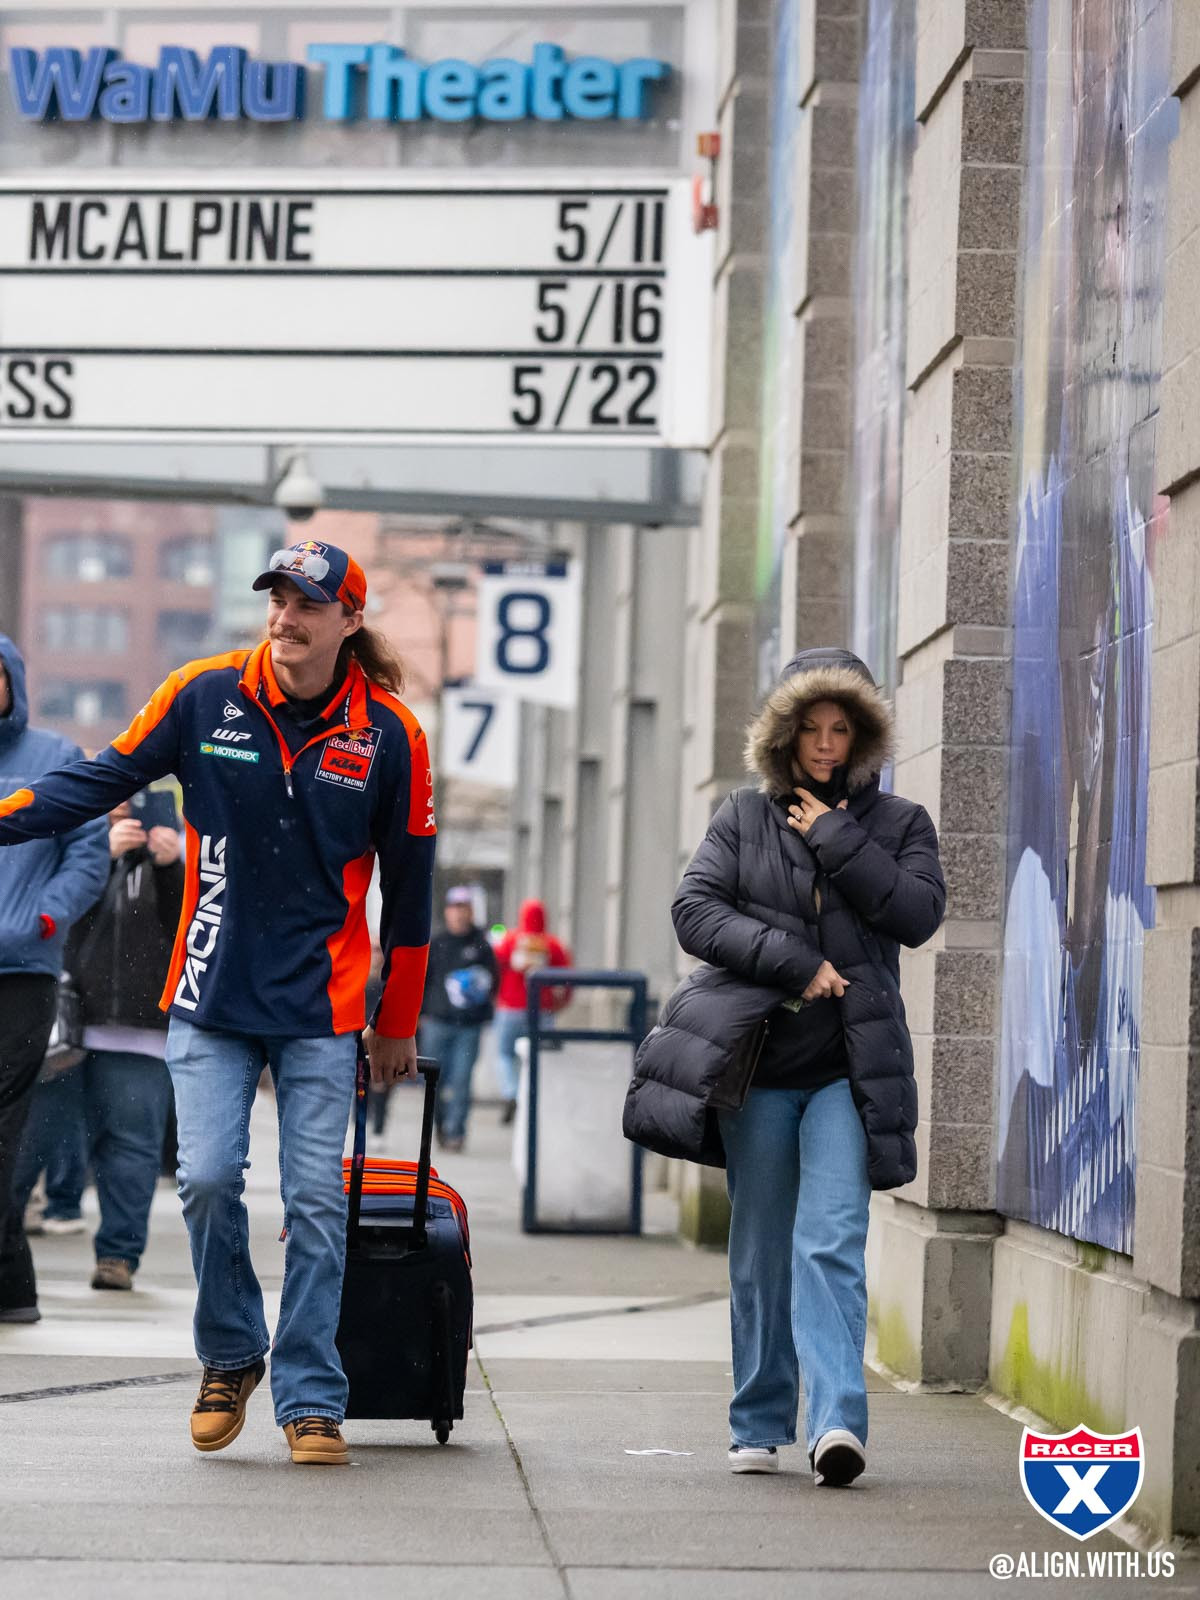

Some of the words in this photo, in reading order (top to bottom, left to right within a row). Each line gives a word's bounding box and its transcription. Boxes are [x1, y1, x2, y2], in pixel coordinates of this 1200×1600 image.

[10, 46, 305, 122] WaMu
[307, 42, 671, 121] Theater
[30, 202, 314, 261] MCALPINE
[557, 202, 664, 264] 5/11
[536, 283, 662, 344] 5/16
[513, 364, 657, 427] 5/22
[496, 592, 551, 674] 8
[211, 729, 252, 742] WP
[213, 746, 257, 761] MOTOREX
[328, 736, 351, 751] Red
[351, 740, 375, 758] Bull
[459, 703, 495, 763] 7
[319, 770, 343, 782] FACTORY
[343, 776, 364, 788] RACING
[329, 757, 362, 773] KTM
